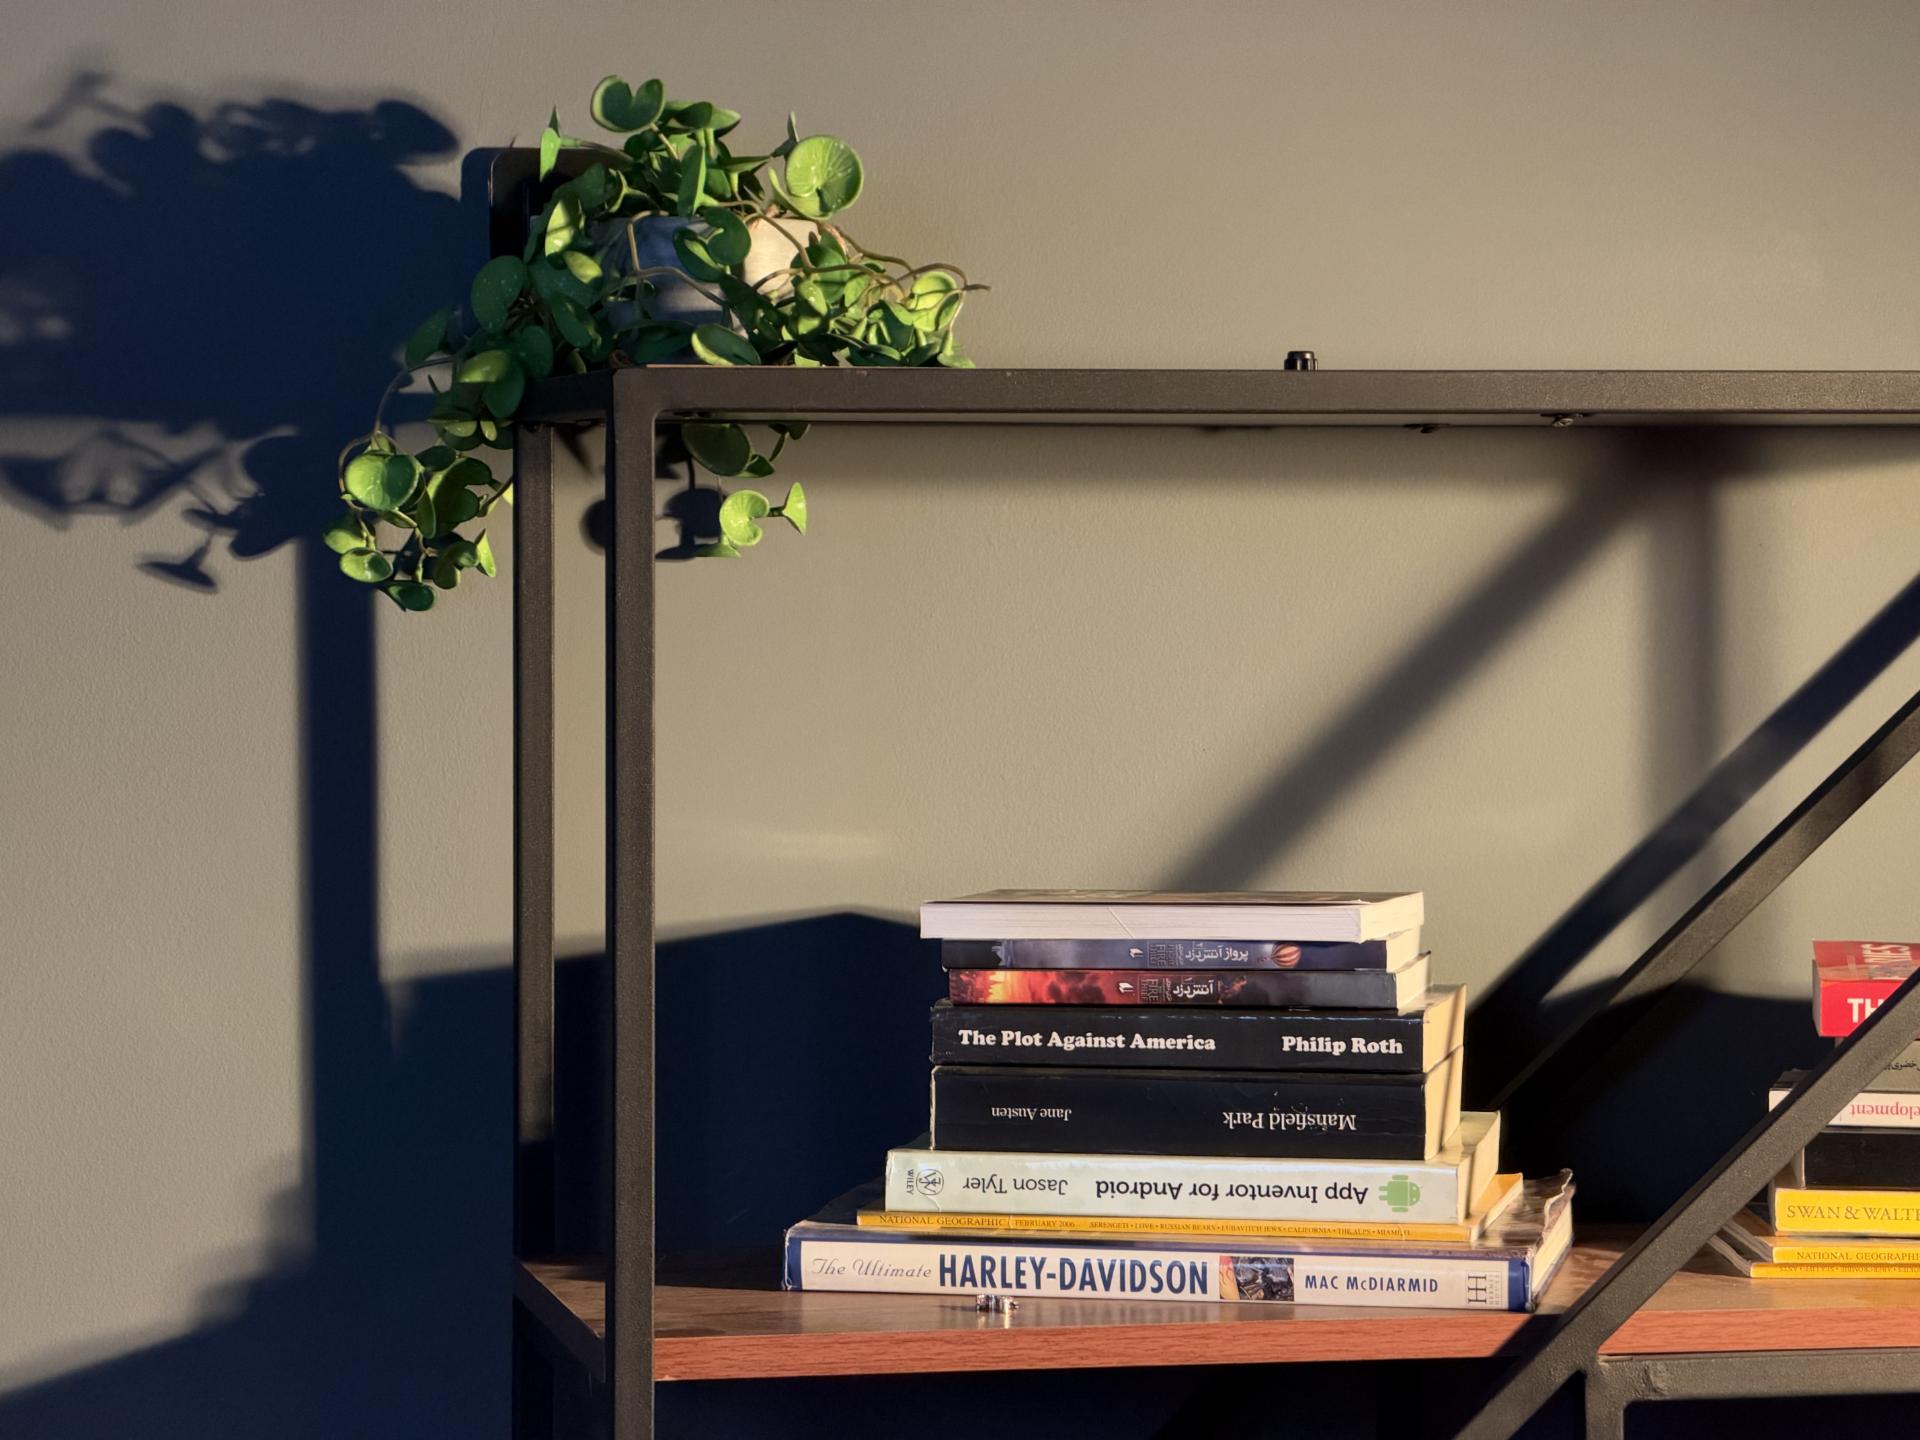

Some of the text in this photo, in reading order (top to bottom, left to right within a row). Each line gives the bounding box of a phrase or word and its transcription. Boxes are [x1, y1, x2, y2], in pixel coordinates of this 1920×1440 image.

[1148, 978, 1159, 1001] FIRE
[958, 1029, 1216, 1051] The Plot Against America
[1281, 1036, 1403, 1056] Philip Roth
[991, 1107, 1072, 1121] Jane Austen
[1222, 1111, 1357, 1131] Mansfield Park
[905, 1168, 915, 1195] WILEY
[963, 1173, 1068, 1195] Jason Tyler
[1095, 1180, 1369, 1204] App Inventor for Android
[1786, 1205, 1841, 1219] SWAN
[1844, 1205, 1860, 1220] &
[879, 1215, 934, 1225] NATIONAL
[936, 1216, 1006, 1226] GEOGRAPHIC
[1015, 1218, 1057, 1228] FEBRUARY
[1060, 1220, 1075, 1228] 2006
[1088, 1221, 1129, 1229] SERENGETI
[1135, 1222, 1154, 1230] LOVE
[1192, 1223, 1216, 1231] BEARS
[1221, 1224, 1261, 1232] LUBAVITCH
[1287, 1225, 1331, 1233] CALIFORNIA
[1796, 1252, 1850, 1260] NATIONAL
[811, 1254, 1209, 1295] The Ultimate HARLEY-DAVIDSON
[1304, 1275, 1438, 1293] MAC McDIARMID
